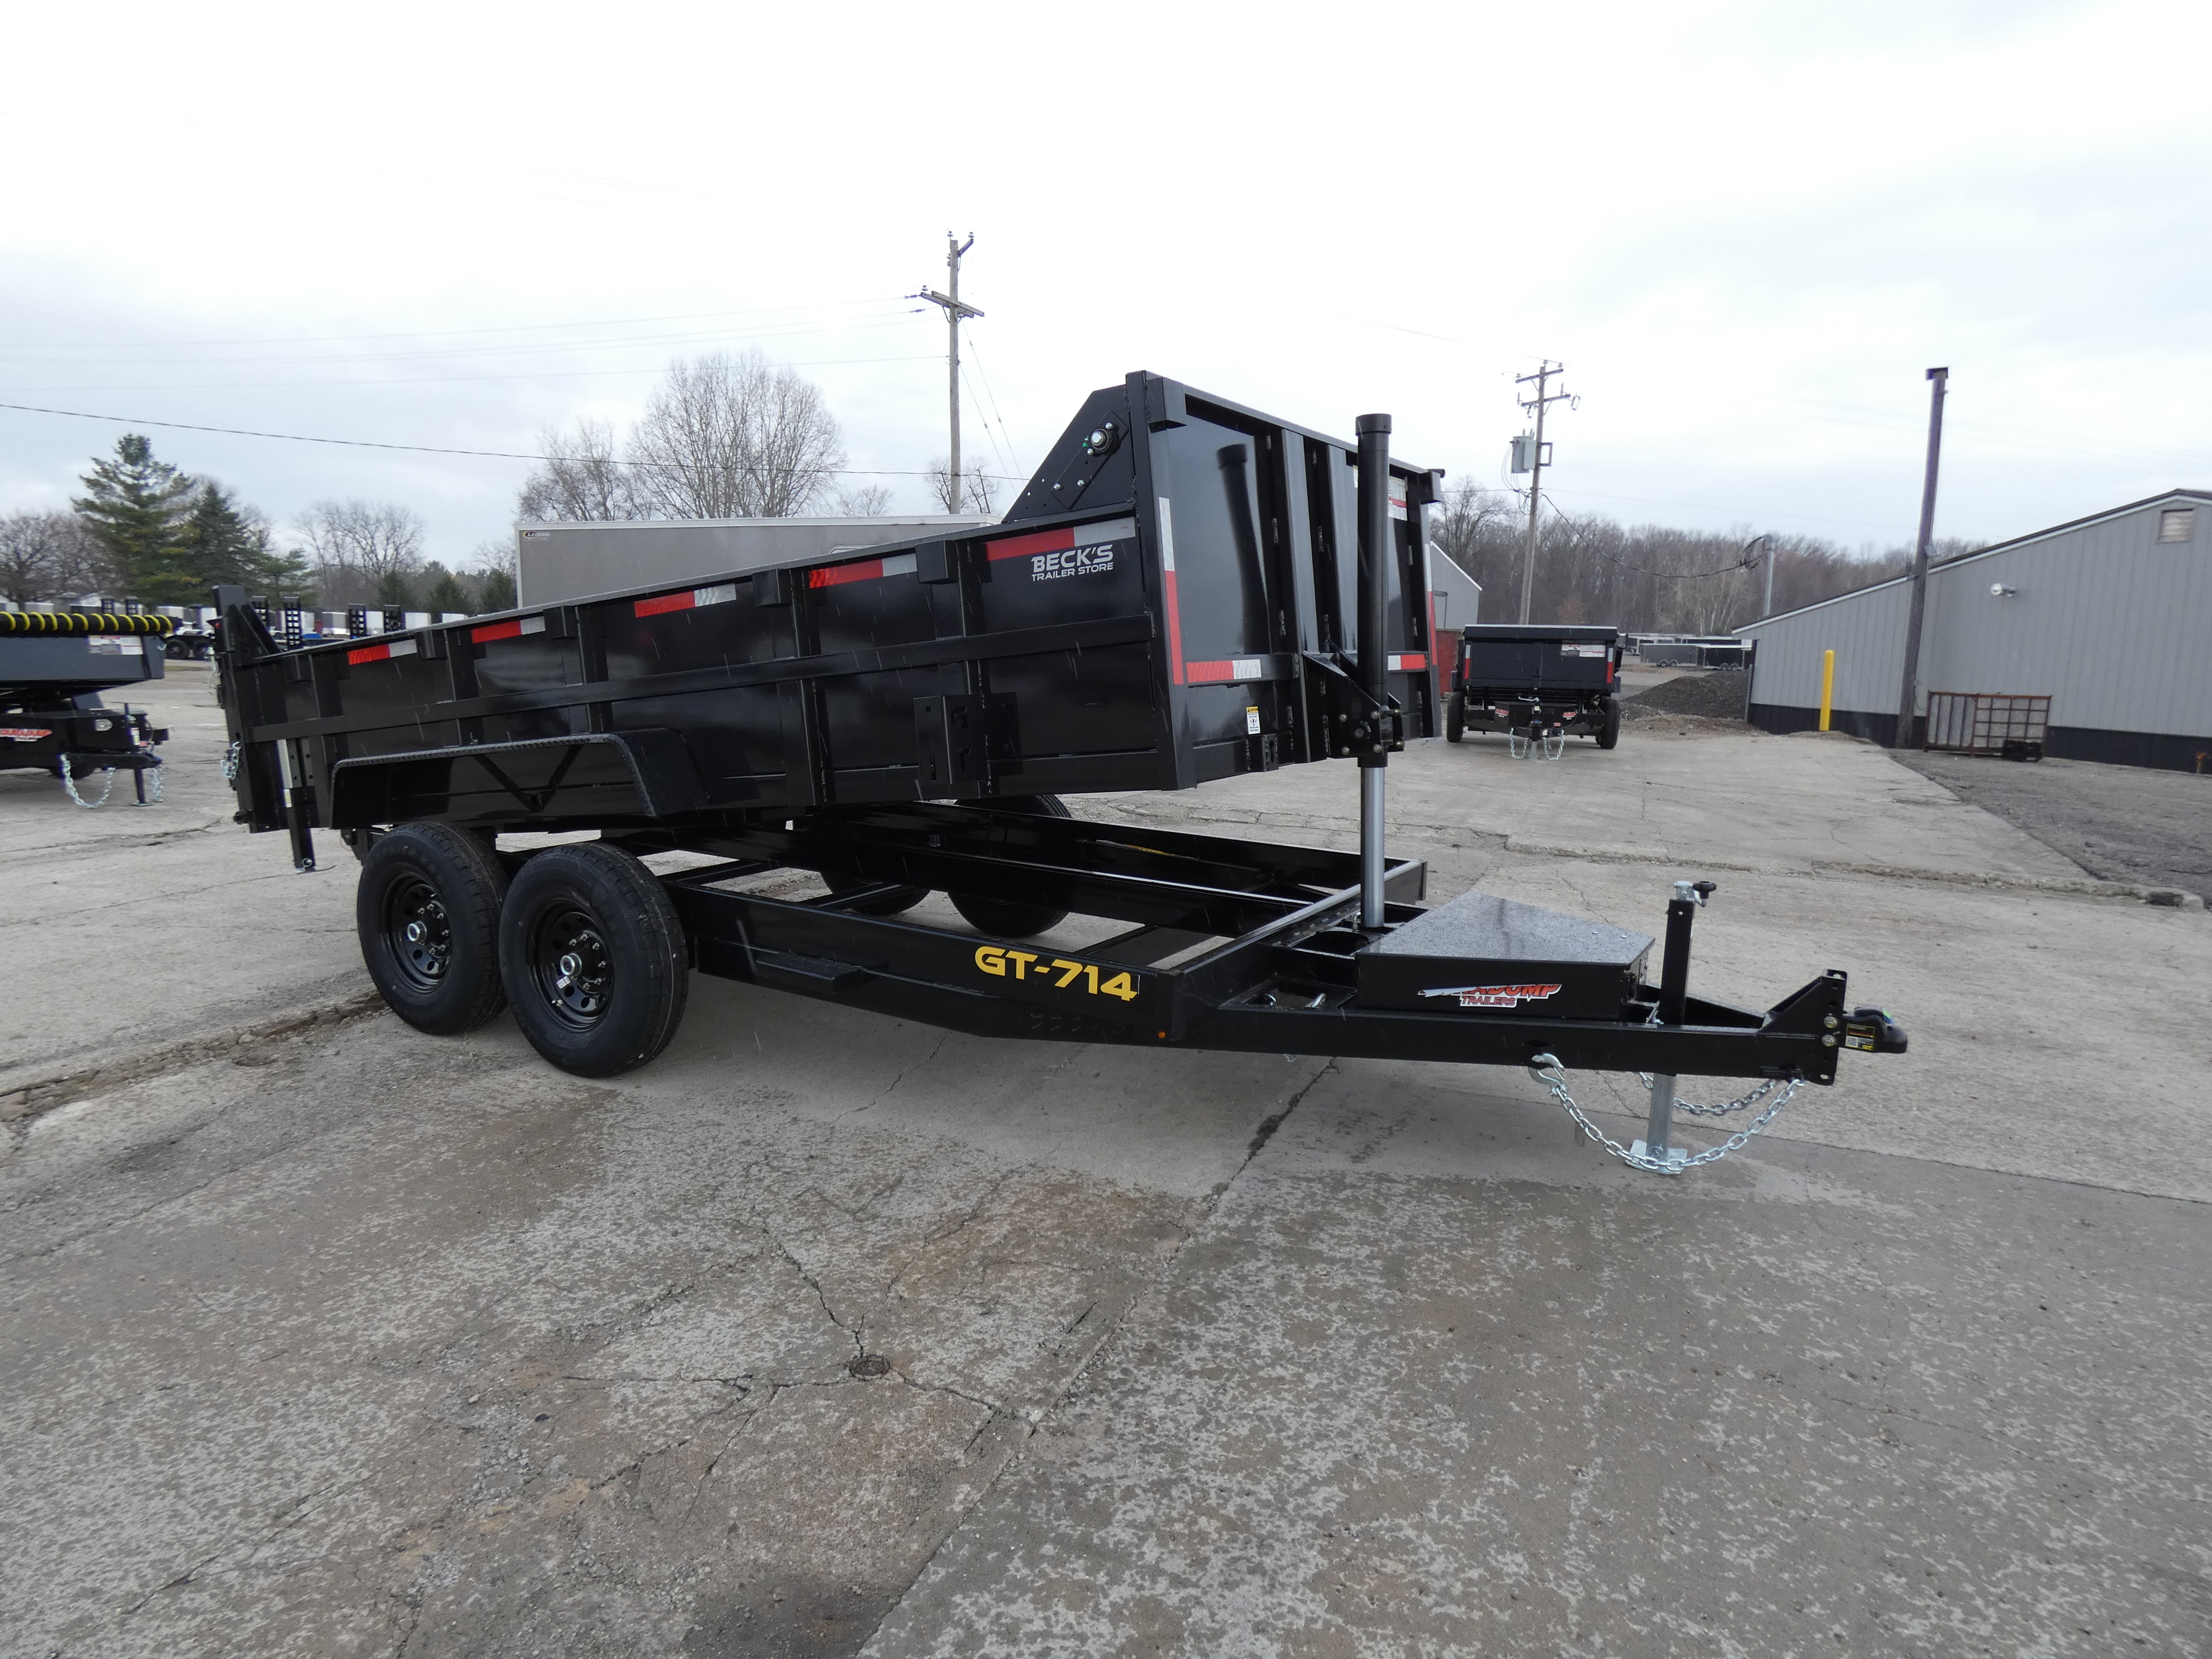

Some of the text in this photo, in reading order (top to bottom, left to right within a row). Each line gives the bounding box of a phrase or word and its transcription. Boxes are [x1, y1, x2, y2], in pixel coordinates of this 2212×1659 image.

[1031, 544, 1114, 572] BECK'S
[1031, 562, 1114, 581] TRAILER STORE
[975, 946, 1138, 1002] GT-714
[1462, 995, 1516, 1006] TRAILERS
